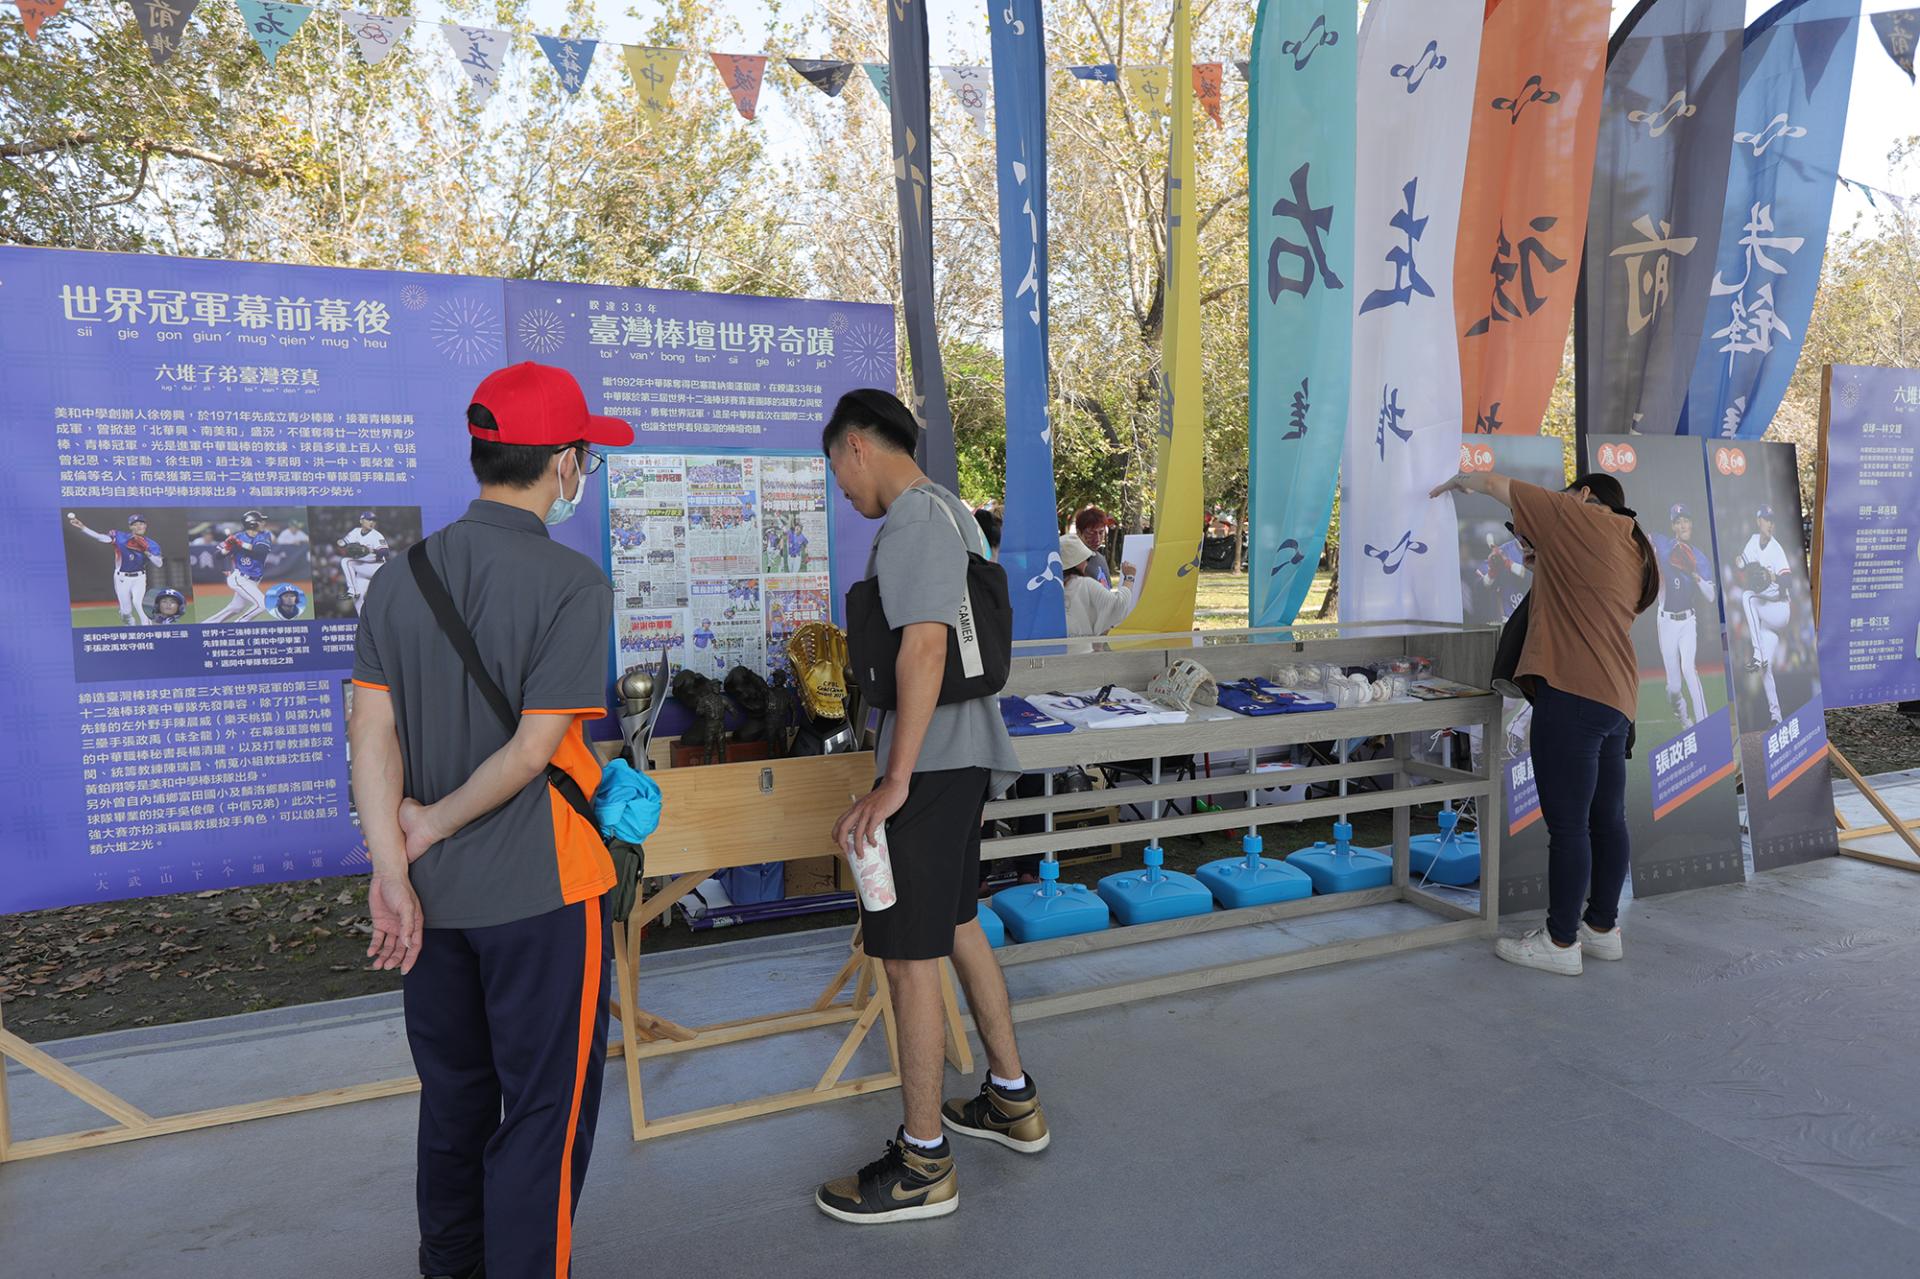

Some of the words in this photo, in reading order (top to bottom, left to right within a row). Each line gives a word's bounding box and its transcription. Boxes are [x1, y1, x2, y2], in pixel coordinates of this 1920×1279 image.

[58, 284, 391, 336] 世界冠軍幕前幕後
[76, 326, 93, 337] sii
[118, 328, 139, 340] gie
[156, 331, 183, 342] gon
[363, 338, 387, 348] heu
[588, 314, 835, 357] 臺灣棒壇世界奇蹟
[661, 352, 685, 363] bong
[155, 363, 320, 386] 六堆子弟臺灣登真
[958, 605, 974, 643] CAMIER
[79, 680, 330, 704] 締造臺灣棒球史首度三大賽世界冠軍的第三屆
[80, 694, 330, 719] 十二強棒球賽中華隊先發陣容，除了打第一棒
[1768, 717, 1800, 759] 吳俊偉
[1655, 731, 1698, 777] 張政禹
[88, 807, 338, 841] 強大賽亦扮演稱職救援投手角色，可以說是另
[89, 839, 163, 855] 類六堆之光。
